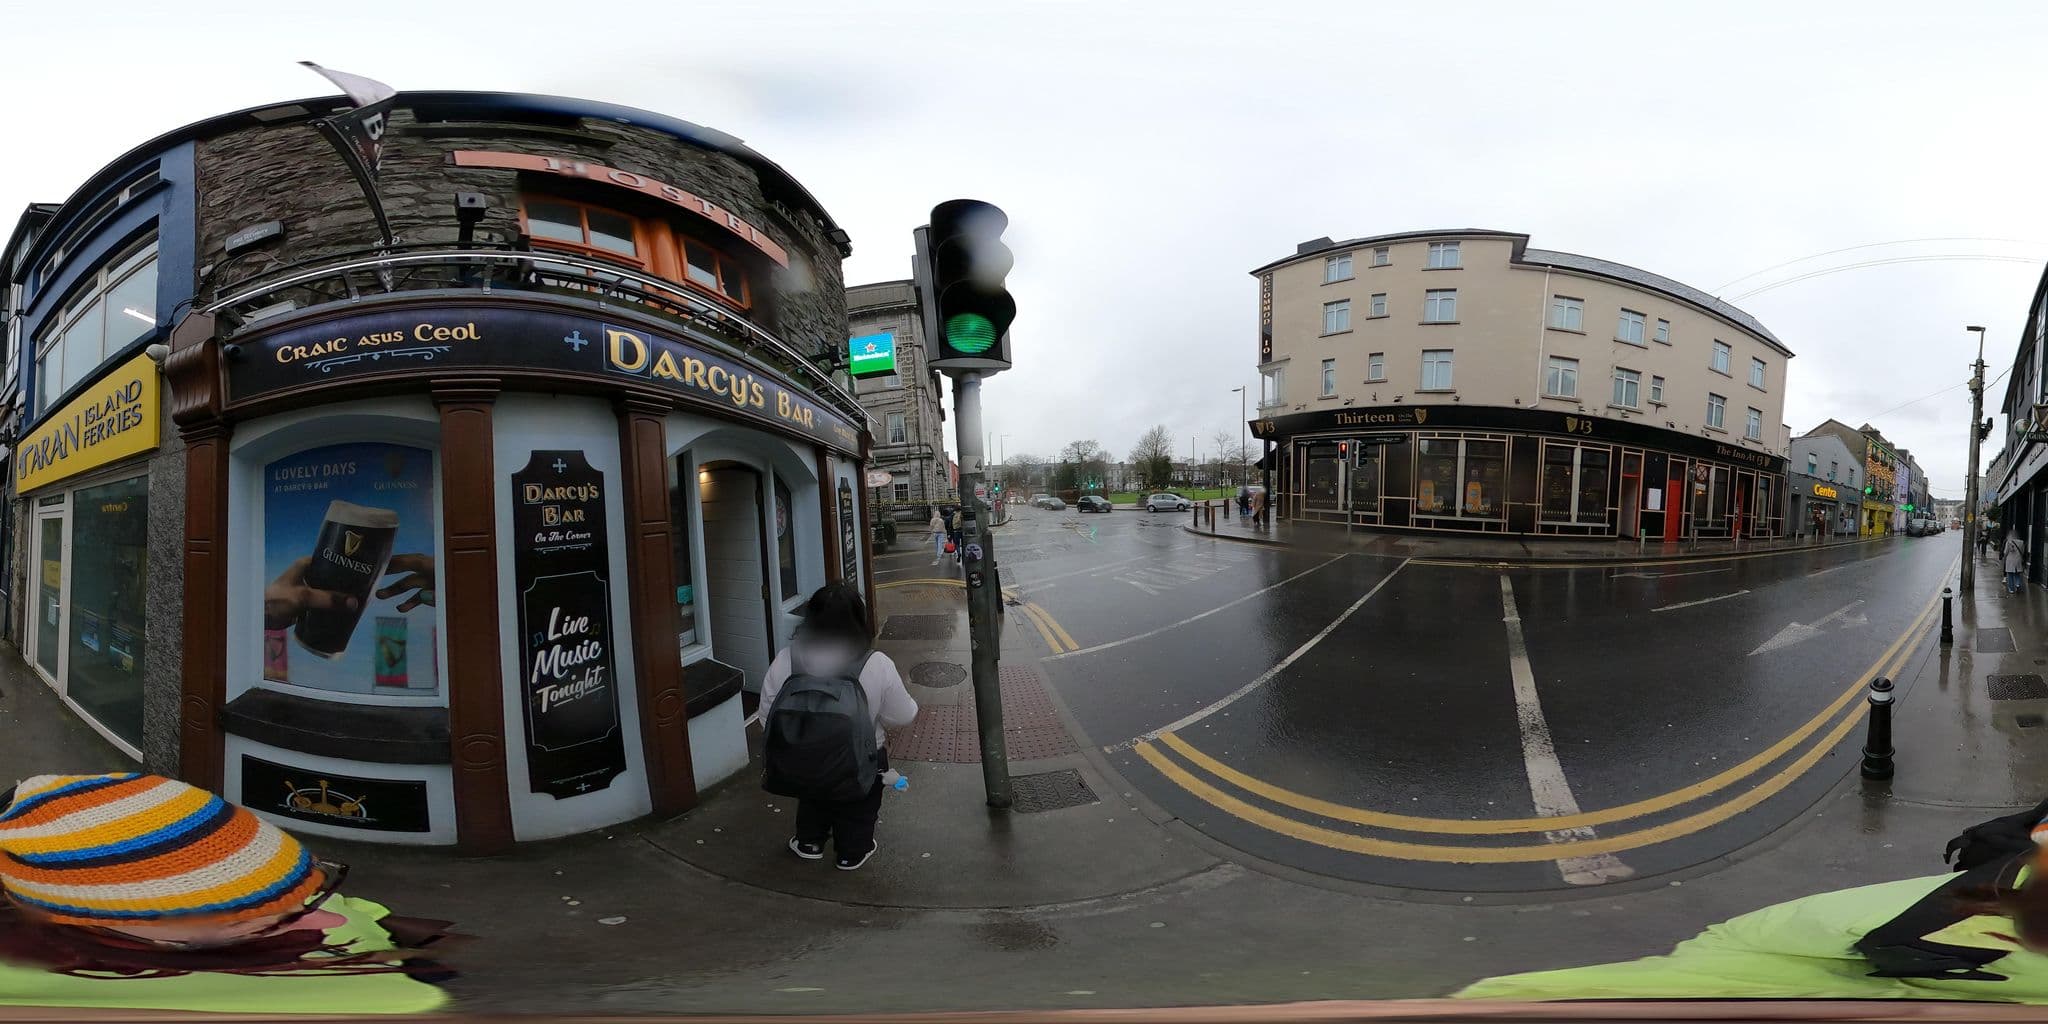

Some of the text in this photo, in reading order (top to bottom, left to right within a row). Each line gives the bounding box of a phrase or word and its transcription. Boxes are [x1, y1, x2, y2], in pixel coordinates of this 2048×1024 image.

[543, 157, 763, 247] HOSTEL
[414, 322, 481, 342] Ceol
[84, 379, 142, 427] ISLAND
[777, 389, 814, 430] BAR
[83, 403, 143, 449] FERRIES
[1334, 411, 1396, 426] Thirteen
[1580, 420, 1593, 435] 13
[275, 461, 356, 481] LOVELY DAYS
[975, 459, 982, 471] 4
[1814, 483, 1837, 498] Centra
[544, 506, 585, 525] BAR
[534, 532, 547, 543] On
[565, 530, 591, 540] Corner
[322, 547, 372, 575] GUINNESS
[547, 606, 589, 641] Live
[531, 640, 602, 684] Music
[535, 666, 605, 713] Tonight
